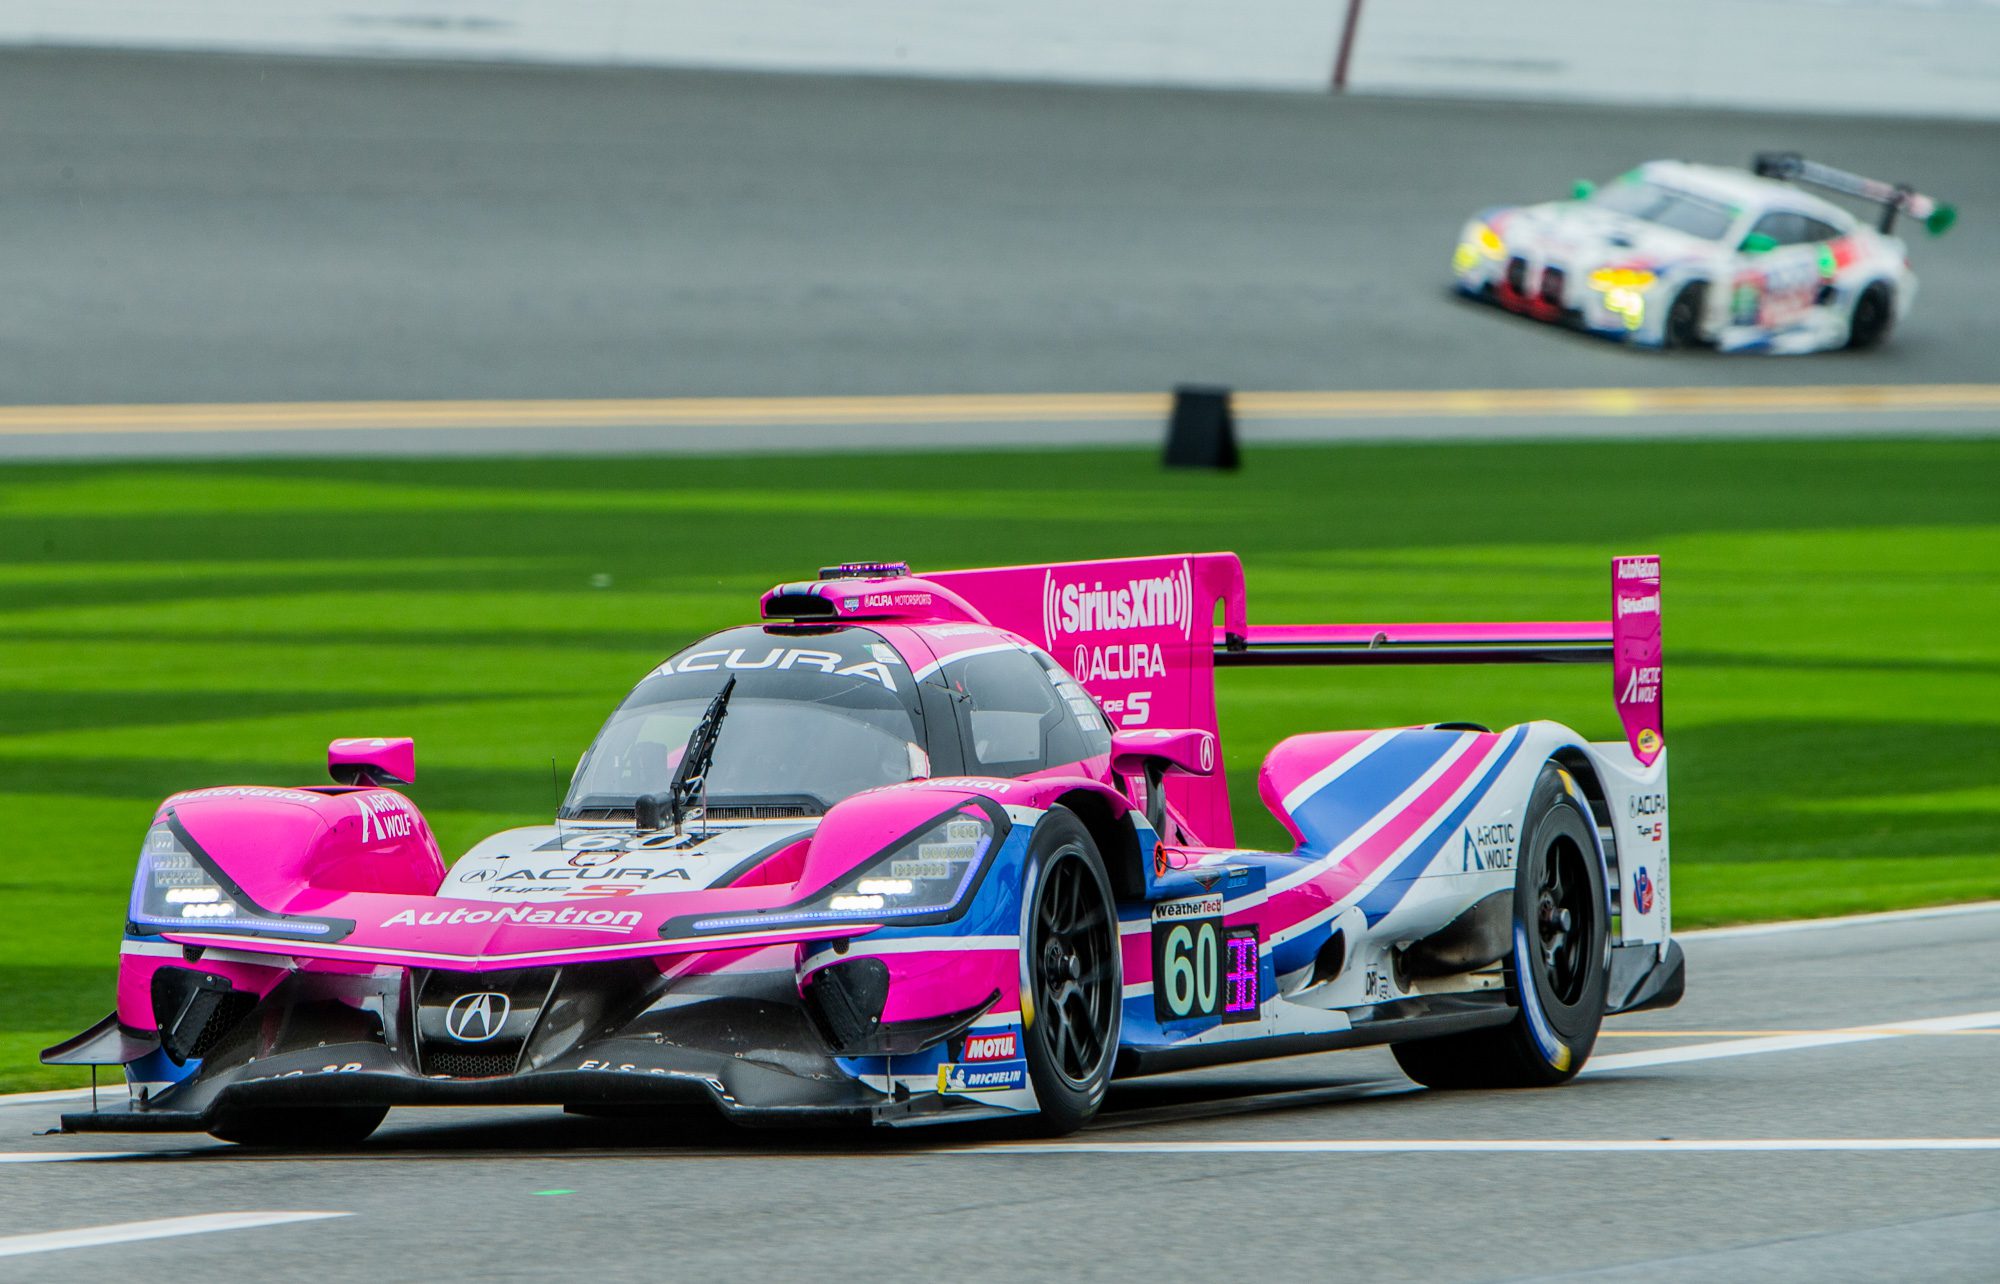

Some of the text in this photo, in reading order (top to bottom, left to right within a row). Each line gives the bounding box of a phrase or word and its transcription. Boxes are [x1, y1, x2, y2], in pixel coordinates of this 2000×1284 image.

[869, 594, 893, 606] ACURA
[894, 594, 932, 606] MOTORSPORTS
[634, 647, 897, 693] ACURA
[1089, 643, 1166, 681] ACURA
[1638, 667, 1661, 684] ARCTIC
[1637, 686, 1657, 703] WOLF
[1121, 691, 1152, 725] S
[166, 788, 321, 803] AutoNation
[366, 793, 408, 813] ARCTIC
[1637, 794, 1666, 816] ACURA
[382, 813, 411, 838] WOLF
[1477, 824, 1514, 846] ARCTIC
[1651, 822, 1663, 842] S
[1484, 849, 1513, 869] WOLF
[498, 867, 692, 881] ACURA
[561, 884, 646, 897] S
[379, 906, 643, 928] AutoNation
[1155, 900, 1222, 917] WeatherTech
[1164, 923, 1218, 1016] 60
[968, 1036, 1015, 1059] MOTUL
[968, 1070, 1021, 1086] MICHELIN
